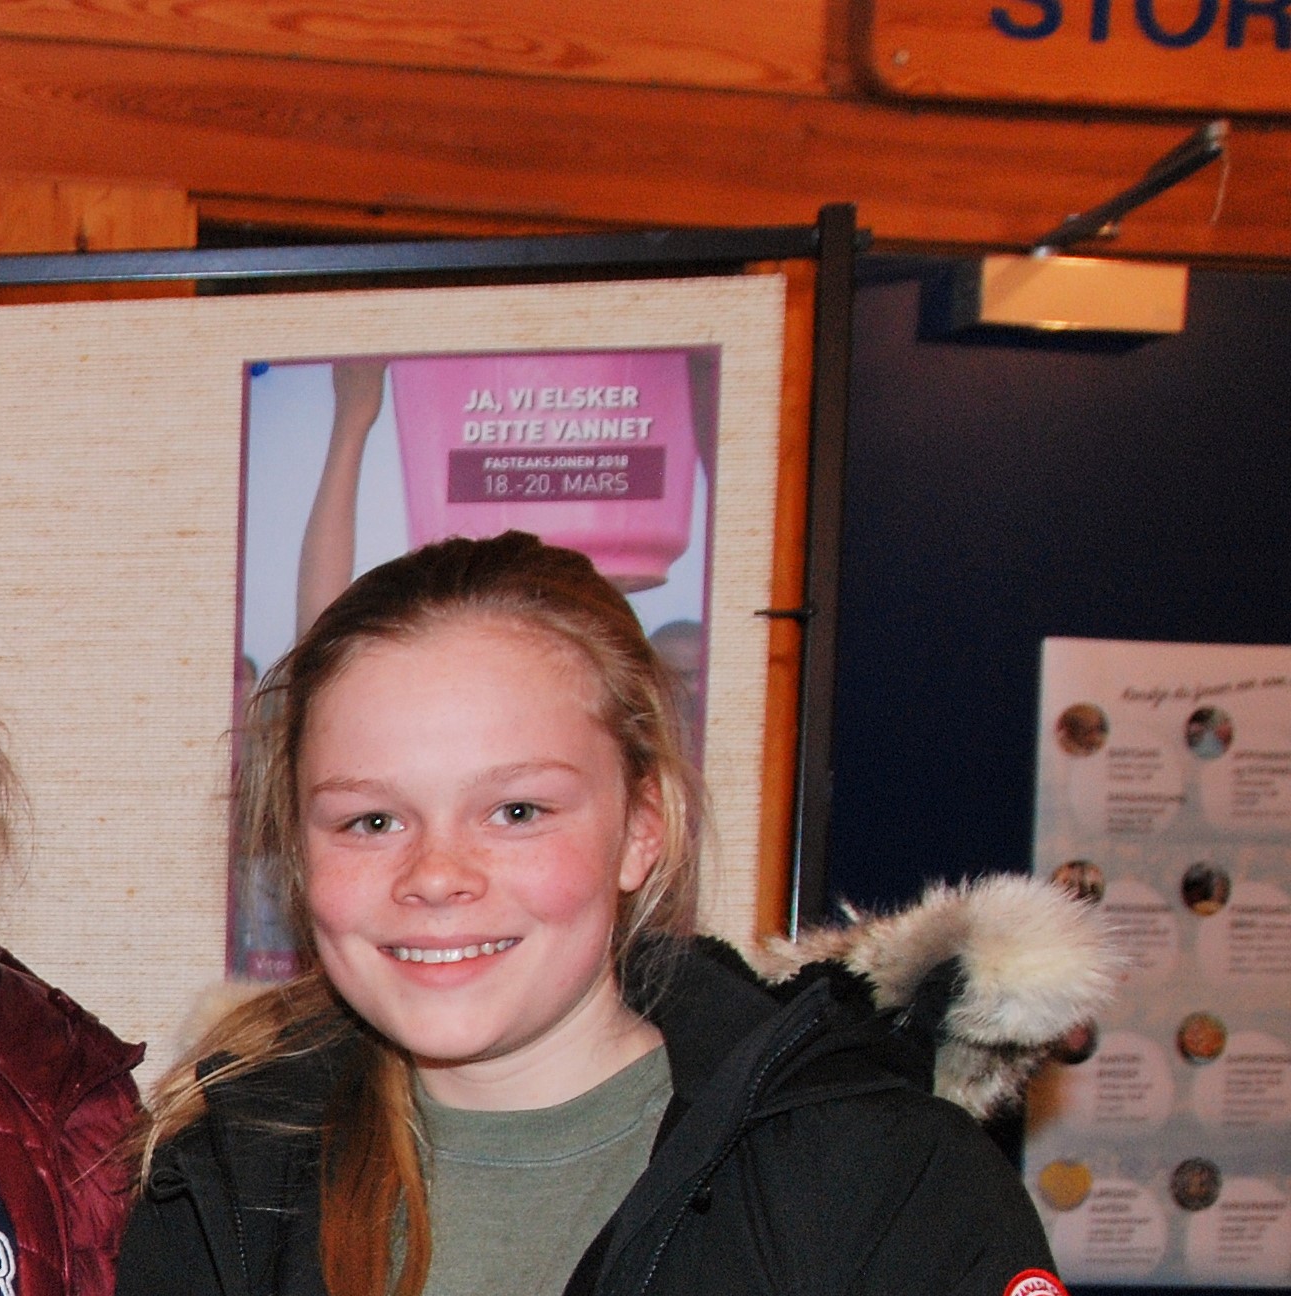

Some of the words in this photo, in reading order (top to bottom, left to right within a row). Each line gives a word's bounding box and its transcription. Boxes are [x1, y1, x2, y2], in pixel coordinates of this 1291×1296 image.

[464, 389, 503, 413] JA,
[510, 388, 534, 410] VI
[538, 385, 640, 409] ELSKER
[464, 420, 545, 442] DETTE
[550, 418, 653, 441] VANNET
[484, 457, 595, 471] FASTEAKSJONEN
[597, 455, 629, 467] 2018
[563, 472, 630, 492] MARS
